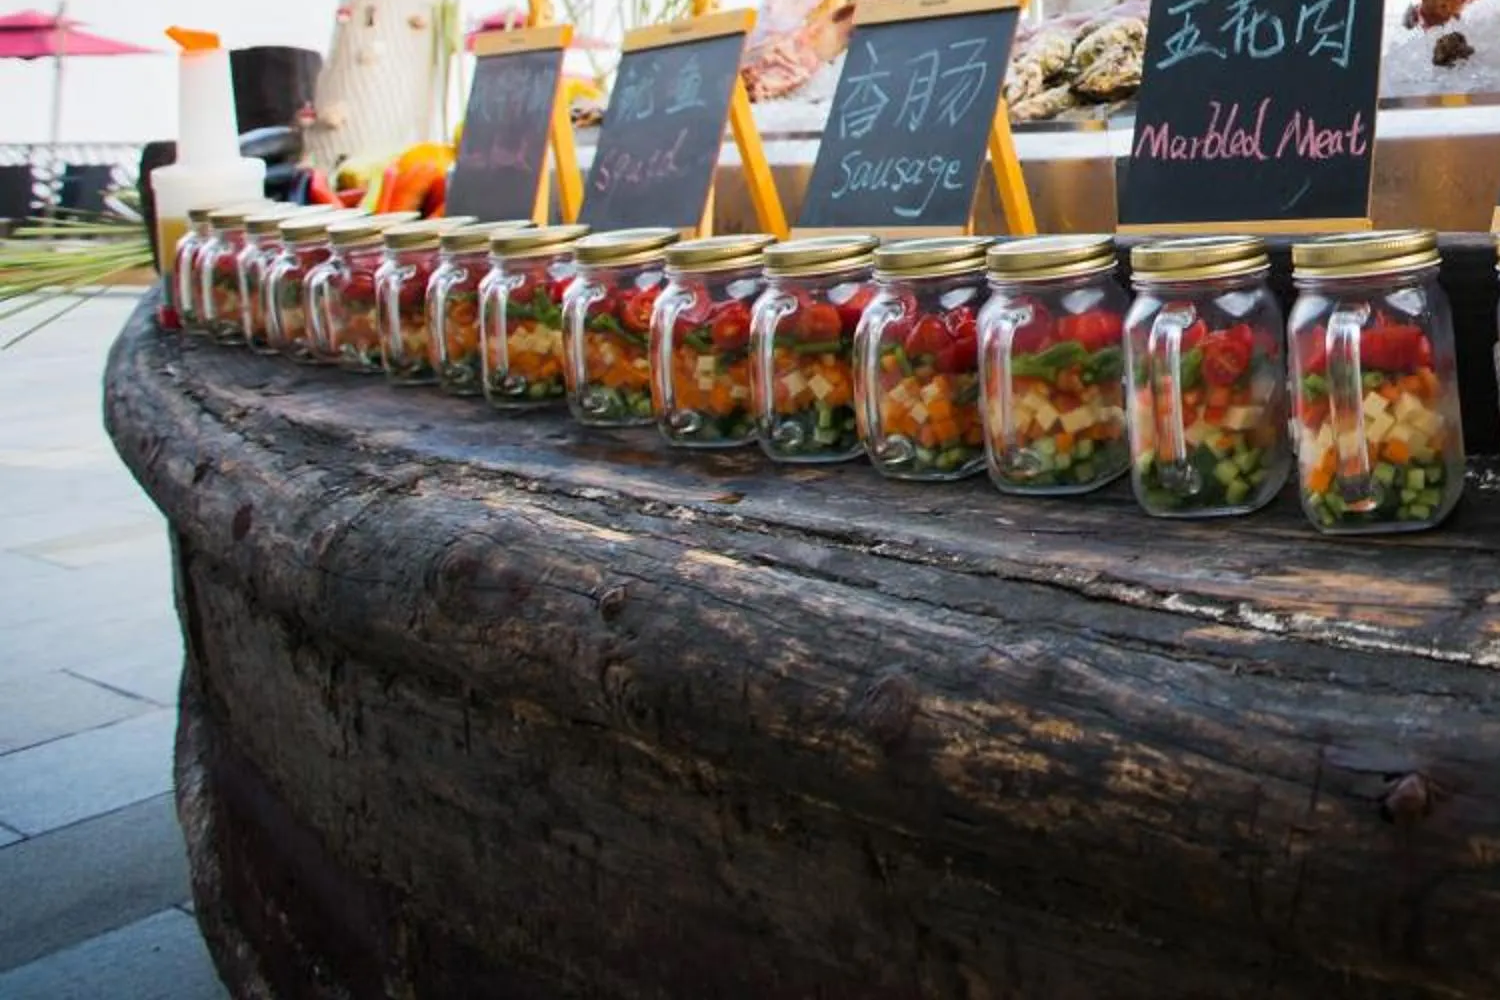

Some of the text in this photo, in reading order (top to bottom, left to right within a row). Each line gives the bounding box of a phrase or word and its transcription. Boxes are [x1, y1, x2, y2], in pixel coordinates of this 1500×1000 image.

[838, 37, 988, 140] 香肠
[1135, 97, 1368, 162] Marbled Meat
